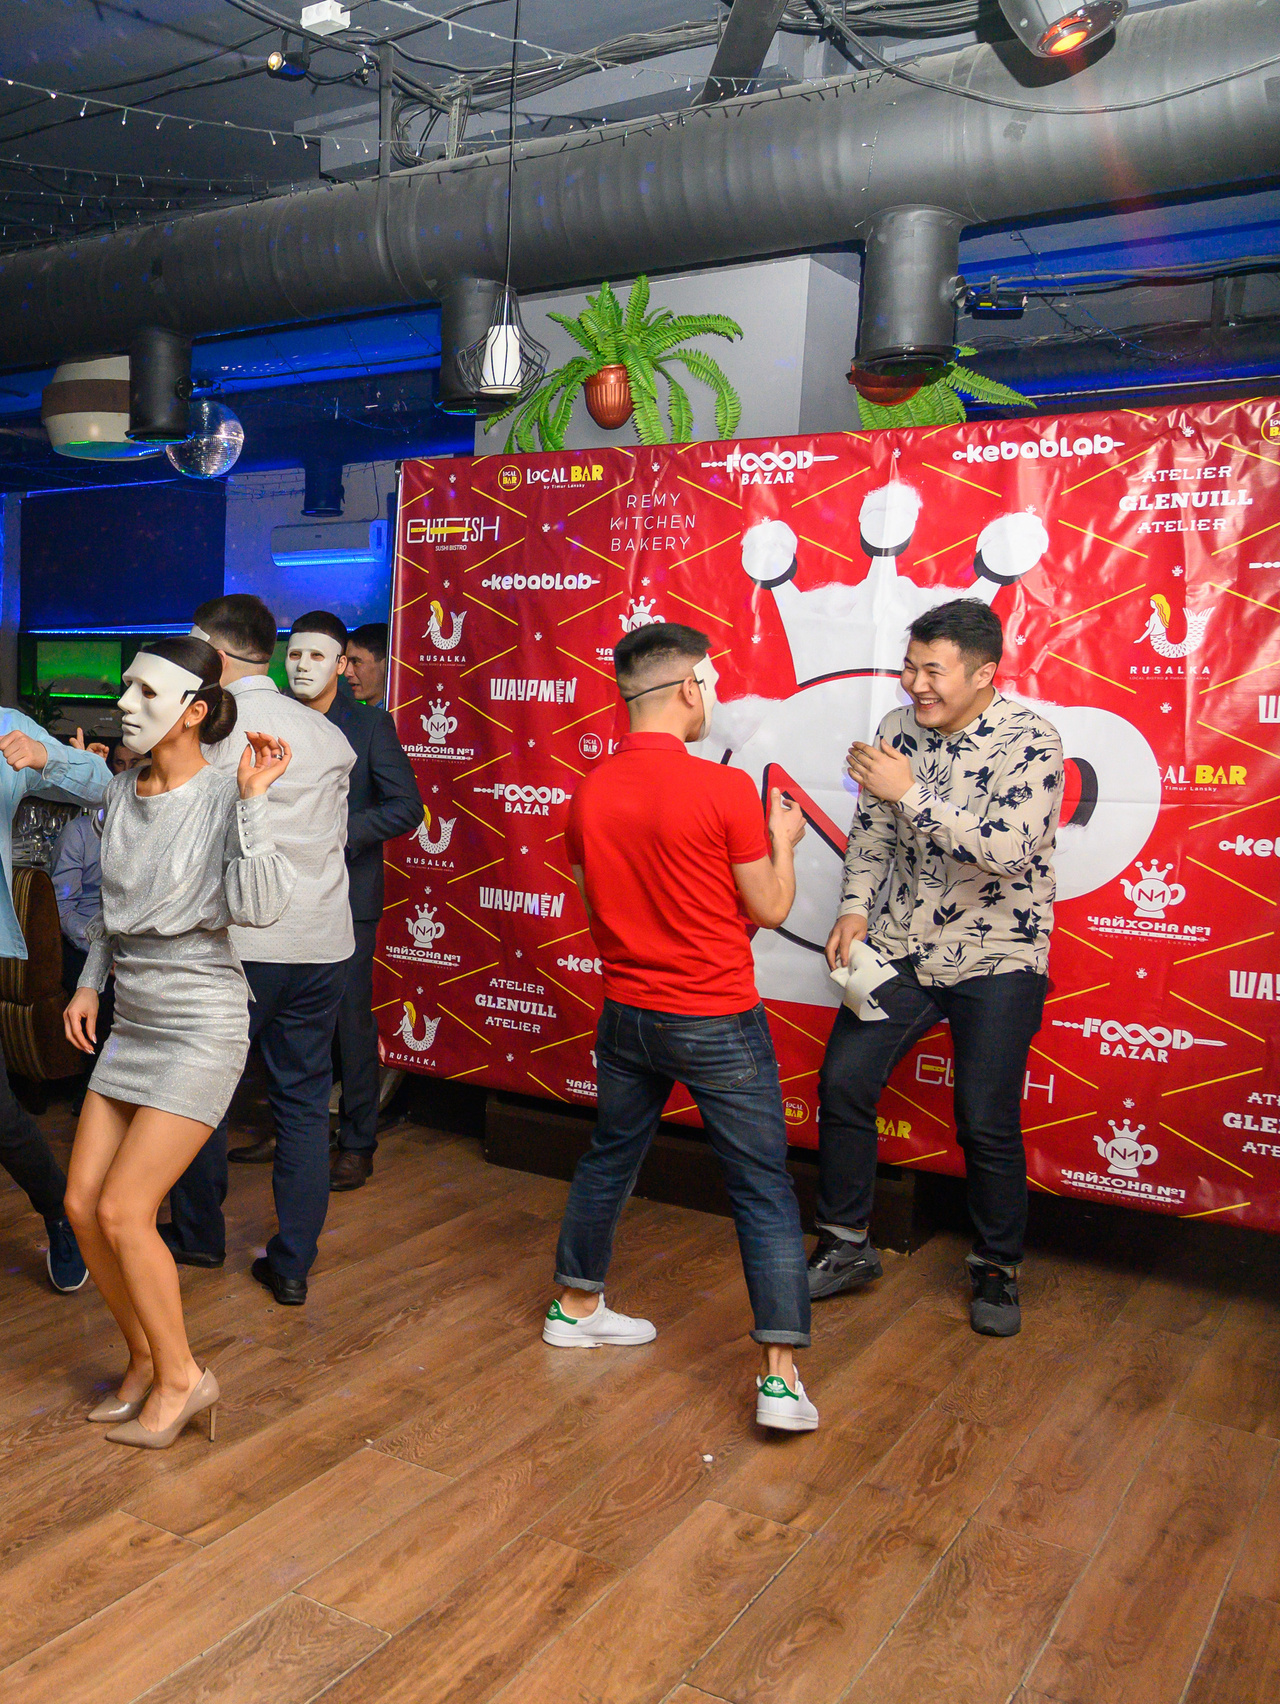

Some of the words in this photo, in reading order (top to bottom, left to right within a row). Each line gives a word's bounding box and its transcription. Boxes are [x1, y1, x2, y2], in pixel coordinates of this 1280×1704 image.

[502, 476, 518, 485] BAR
[570, 464, 604, 482] BAR
[741, 471, 795, 486] BAZAR
[1142, 465, 1232, 483] ATELIER
[626, 492, 681, 509] REMY
[1118, 489, 1254, 511] GLENUILL
[406, 515, 500, 544] CUTFISH
[609, 514, 696, 531] KITCHEN
[1137, 518, 1228, 534] ATELIER
[610, 536, 691, 552] BAKERY
[419, 654, 466, 663] RUSALKA
[1129, 665, 1211, 675] RUSALKA
[401, 743, 455, 754] ЧАЙХОНА
[1195, 764, 1248, 785] BAR
[504, 801, 549, 816] BAZAR
[406, 856, 455, 868] RUSALKA
[1087, 915, 1179, 933] ЧАЙХОНА
[1182, 925, 1211, 936] №1
[385, 945, 441, 960] ЧАЙХОНА
[489, 978, 545, 995] ATELIER
[474, 993, 557, 1019] GLENUILL
[484, 1016, 541, 1034] ATELIER
[389, 1051, 436, 1067] RUSALKA
[1099, 1041, 1169, 1063] BAZAR
[784, 1108, 804, 1119] BAR
[1061, 1169, 1153, 1193] ЧАЙХОНА
[1157, 1185, 1186, 1199] №1
